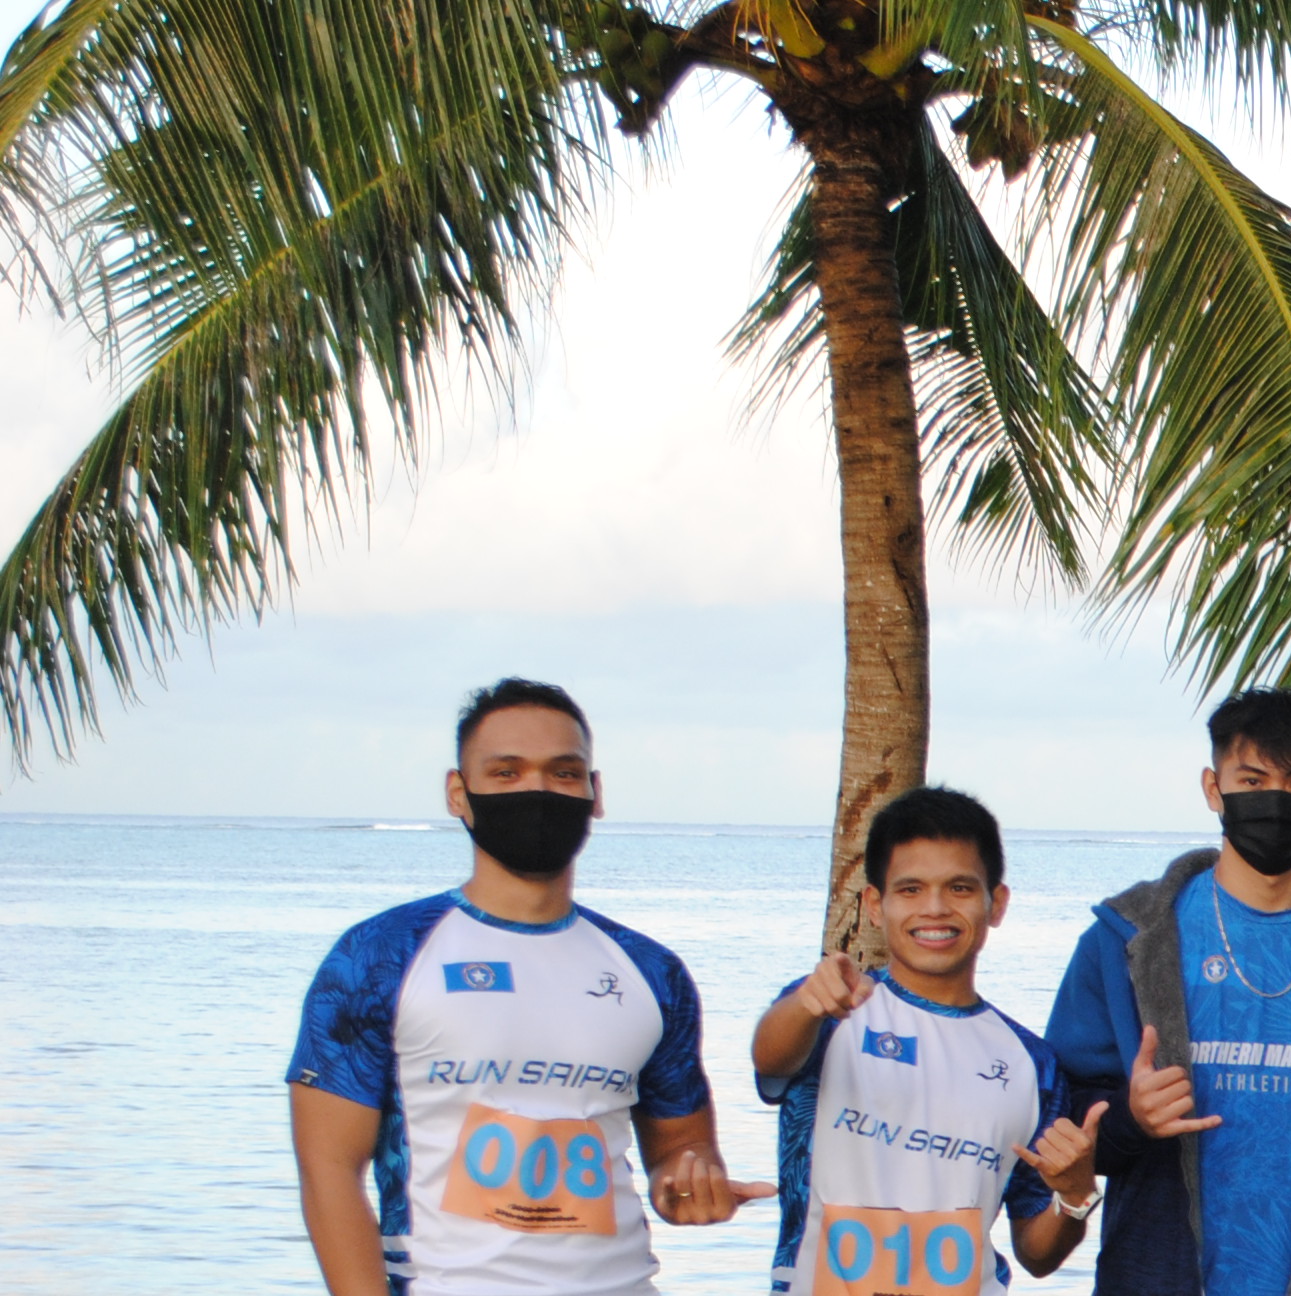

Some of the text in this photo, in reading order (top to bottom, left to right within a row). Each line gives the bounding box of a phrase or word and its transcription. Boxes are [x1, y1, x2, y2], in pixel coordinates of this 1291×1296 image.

[428, 1060, 512, 1085] RUN
[1189, 1041, 1265, 1066] ORTHERN
[464, 1122, 609, 1200] 008
[833, 1107, 1005, 1173] RUN SAIPAN
[826, 1219, 975, 1286] 010
